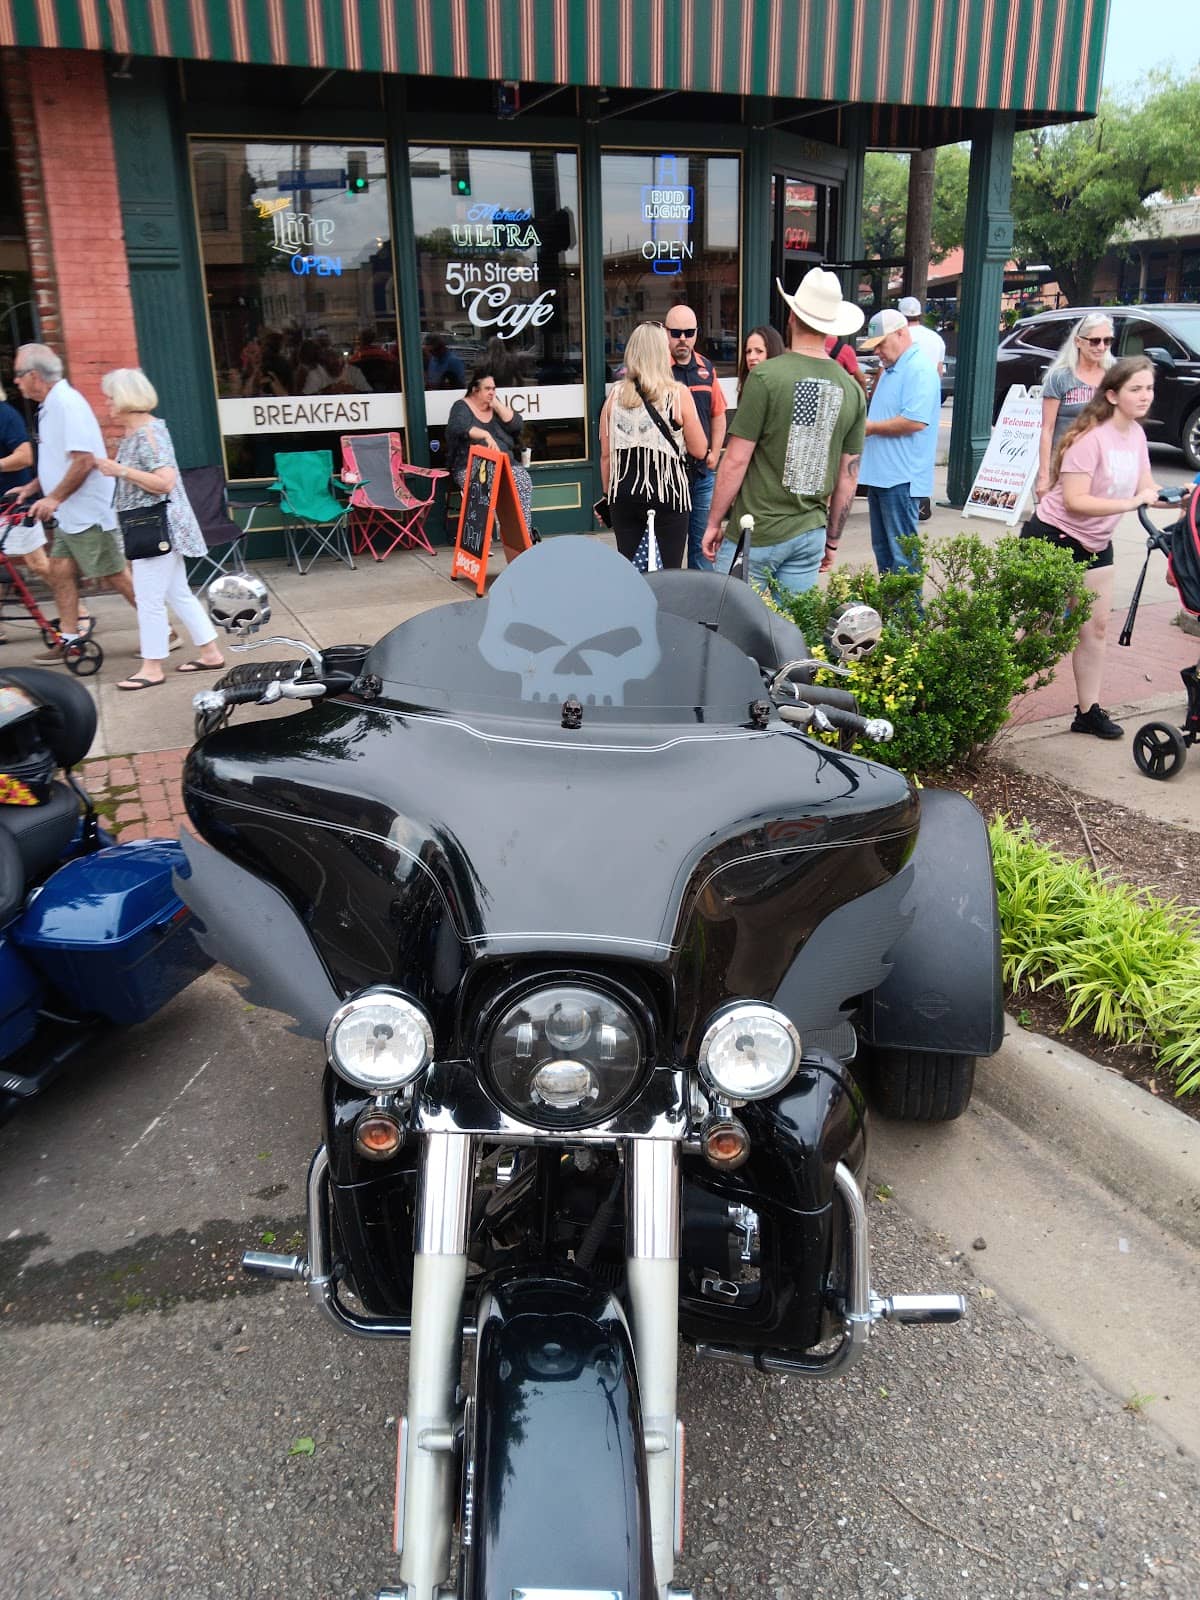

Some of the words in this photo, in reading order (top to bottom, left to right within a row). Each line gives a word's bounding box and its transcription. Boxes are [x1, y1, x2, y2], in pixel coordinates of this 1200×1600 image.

[651, 190, 685, 205] BUD
[645, 204, 691, 219] LIGHT
[271, 211, 336, 255] Lite
[452, 223, 542, 247] ULTRA
[784, 227, 810, 250] OPEN
[641, 240, 694, 260] OPEN
[290, 254, 343, 277] OPEN
[445, 262, 482, 296] 5th
[484, 262, 540, 283] Street
[461, 282, 557, 340] Cafe
[253, 401, 370, 426] BREAKFAST
[1002, 416, 1035, 428] Welcome
